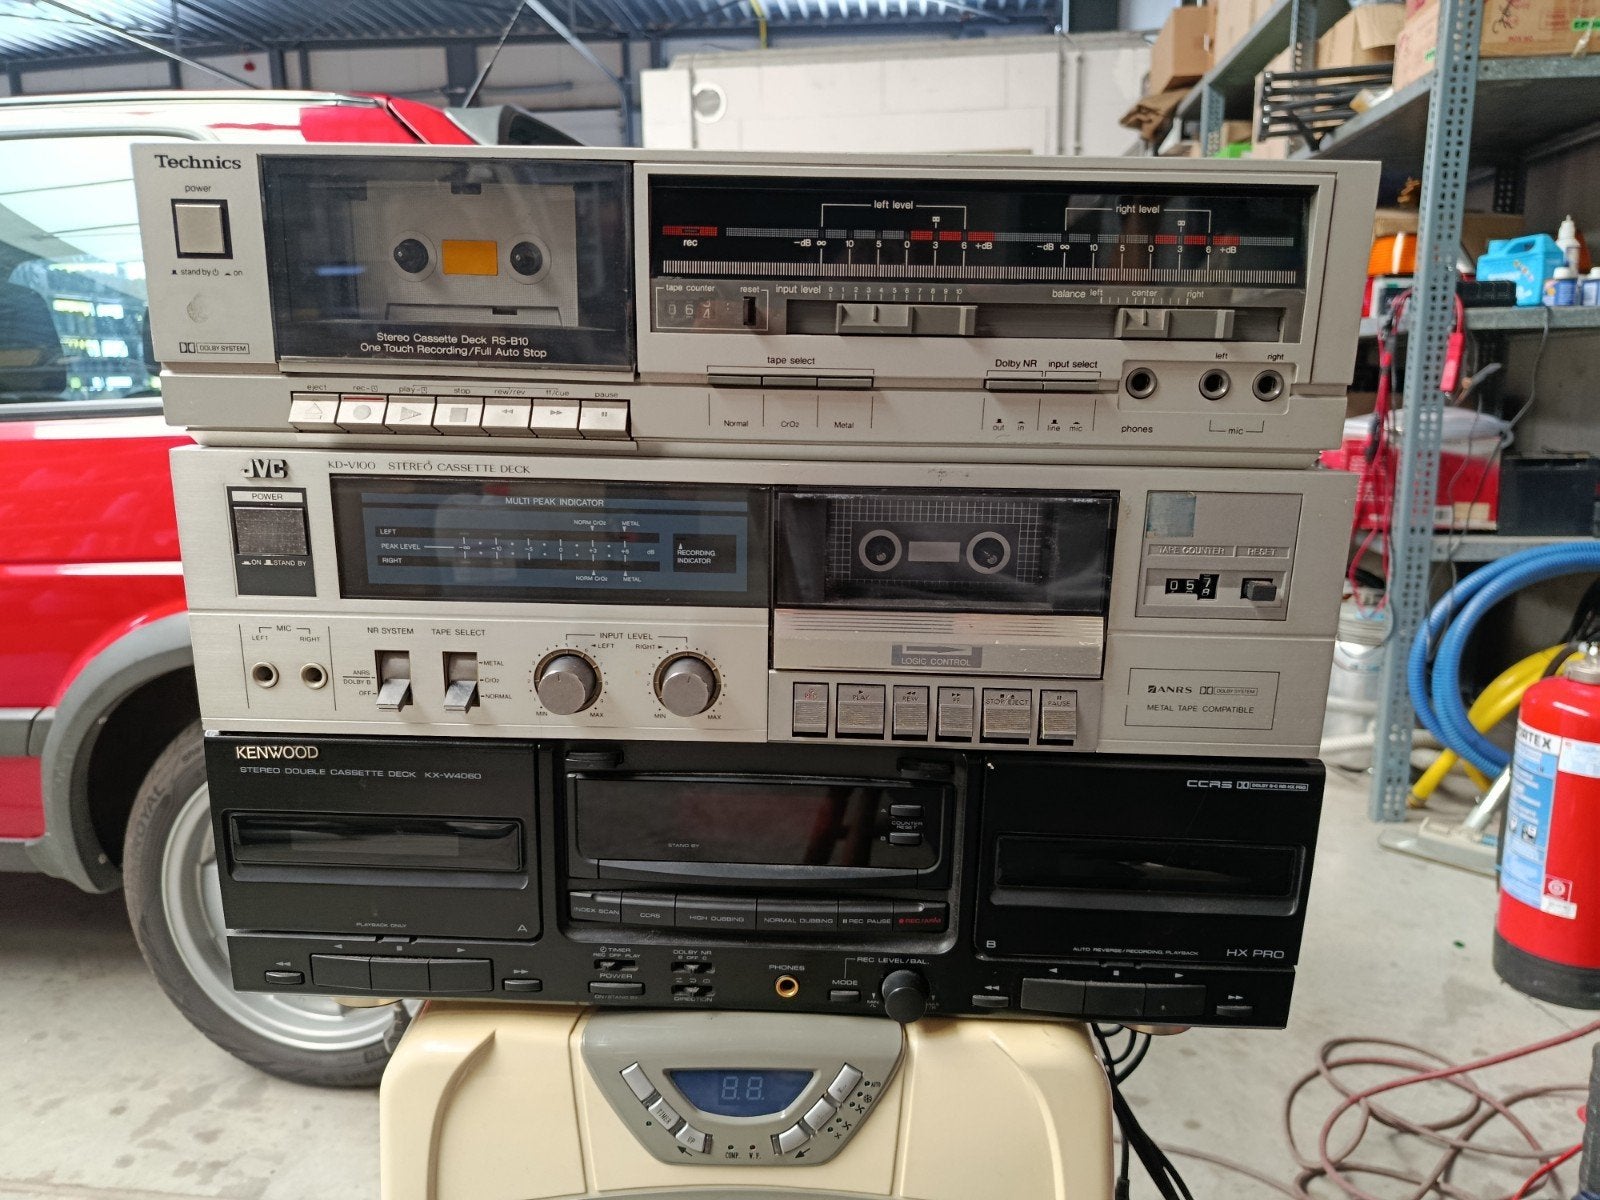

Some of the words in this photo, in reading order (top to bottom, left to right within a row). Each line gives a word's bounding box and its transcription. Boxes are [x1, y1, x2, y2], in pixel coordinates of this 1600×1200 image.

[154, 154, 241, 169] Technics
[185, 185, 211, 193] power
[873, 200, 889, 209] left
[892, 200, 914, 210] level
[1115, 204, 1136, 214] right
[1138, 205, 1160, 214] level
[683, 238, 698, 247] rec
[845, 240, 854, 248] 10
[875, 240, 882, 248] 5
[904, 241, 911, 249] 0
[961, 242, 968, 250] 6
[1089, 244, 1098, 252] 10
[1147, 245, 1155, 253] 0
[1176, 245, 1184, 253] 3
[180, 268, 200, 276] stand
[201, 268, 211, 276] by
[775, 284, 798, 294] input
[800, 284, 822, 294] level
[1052, 289, 1086, 298] balance
[1131, 289, 1158, 297] center
[1186, 290, 1204, 299] right
[376, 332, 410, 342] Stereo
[413, 333, 458, 344] Cassette
[461, 334, 487, 345] Deck
[491, 336, 529, 346] RS-B10
[360, 342, 381, 352] One
[384, 343, 414, 353] Touch
[417, 345, 492, 357] Recording/Full
[495, 347, 520, 357] Auto
[523, 348, 547, 358] Stop
[767, 356, 787, 365] tape
[790, 356, 816, 365] select
[1215, 352, 1228, 360] left
[1267, 353, 1285, 361] right
[995, 359, 1021, 368] Dolby
[1023, 359, 1038, 367] NR
[1048, 360, 1070, 369] input
[1072, 360, 1098, 369] select
[306, 384, 327, 392] eject
[453, 387, 471, 395] stop
[494, 388, 526, 396] rew/rev
[594, 391, 619, 399] pause
[723, 419, 749, 427] Normal
[834, 421, 855, 429] Metal
[1121, 425, 1153, 434] phones
[1228, 427, 1244, 435] mic
[240, 458, 288, 479] JVC
[328, 460, 376, 470] KD-V100
[388, 461, 433, 471] STEREO
[437, 463, 496, 473] CASSETTE
[500, 465, 531, 474] DECK
[251, 492, 283, 500] POWER
[505, 497, 530, 505] MULTI
[532, 497, 556, 506] PEAK
[559, 498, 604, 507] INDICATOR
[1158, 546, 1179, 554] TAPE
[1182, 546, 1225, 555] COUNTER
[1247, 548, 1276, 556] RESET
[381, 627, 414, 635] SYSTEM
[432, 628, 451, 636] TAPE
[901, 657, 927, 666] LOGIC
[930, 658, 971, 667] CONTROL
[1156, 686, 1192, 694] ANRS
[1147, 704, 1174, 712] METAL
[1202, 705, 1254, 714] COMPATIBLE
[235, 746, 319, 759] KENWOOD
[240, 766, 281, 774] STEREO
[284, 767, 326, 775] DOUBLE
[330, 768, 384, 777] CASSETTE
[388, 770, 417, 778] DECK
[573, 906, 596, 914] INDEX
[598, 908, 620, 916] SCAN
[710, 915, 745, 923] DUBBING
[516, 924, 528, 932] A
[985, 940, 997, 948] B
[1226, 948, 1248, 957] HX
[1252, 949, 1285, 959] PRO
